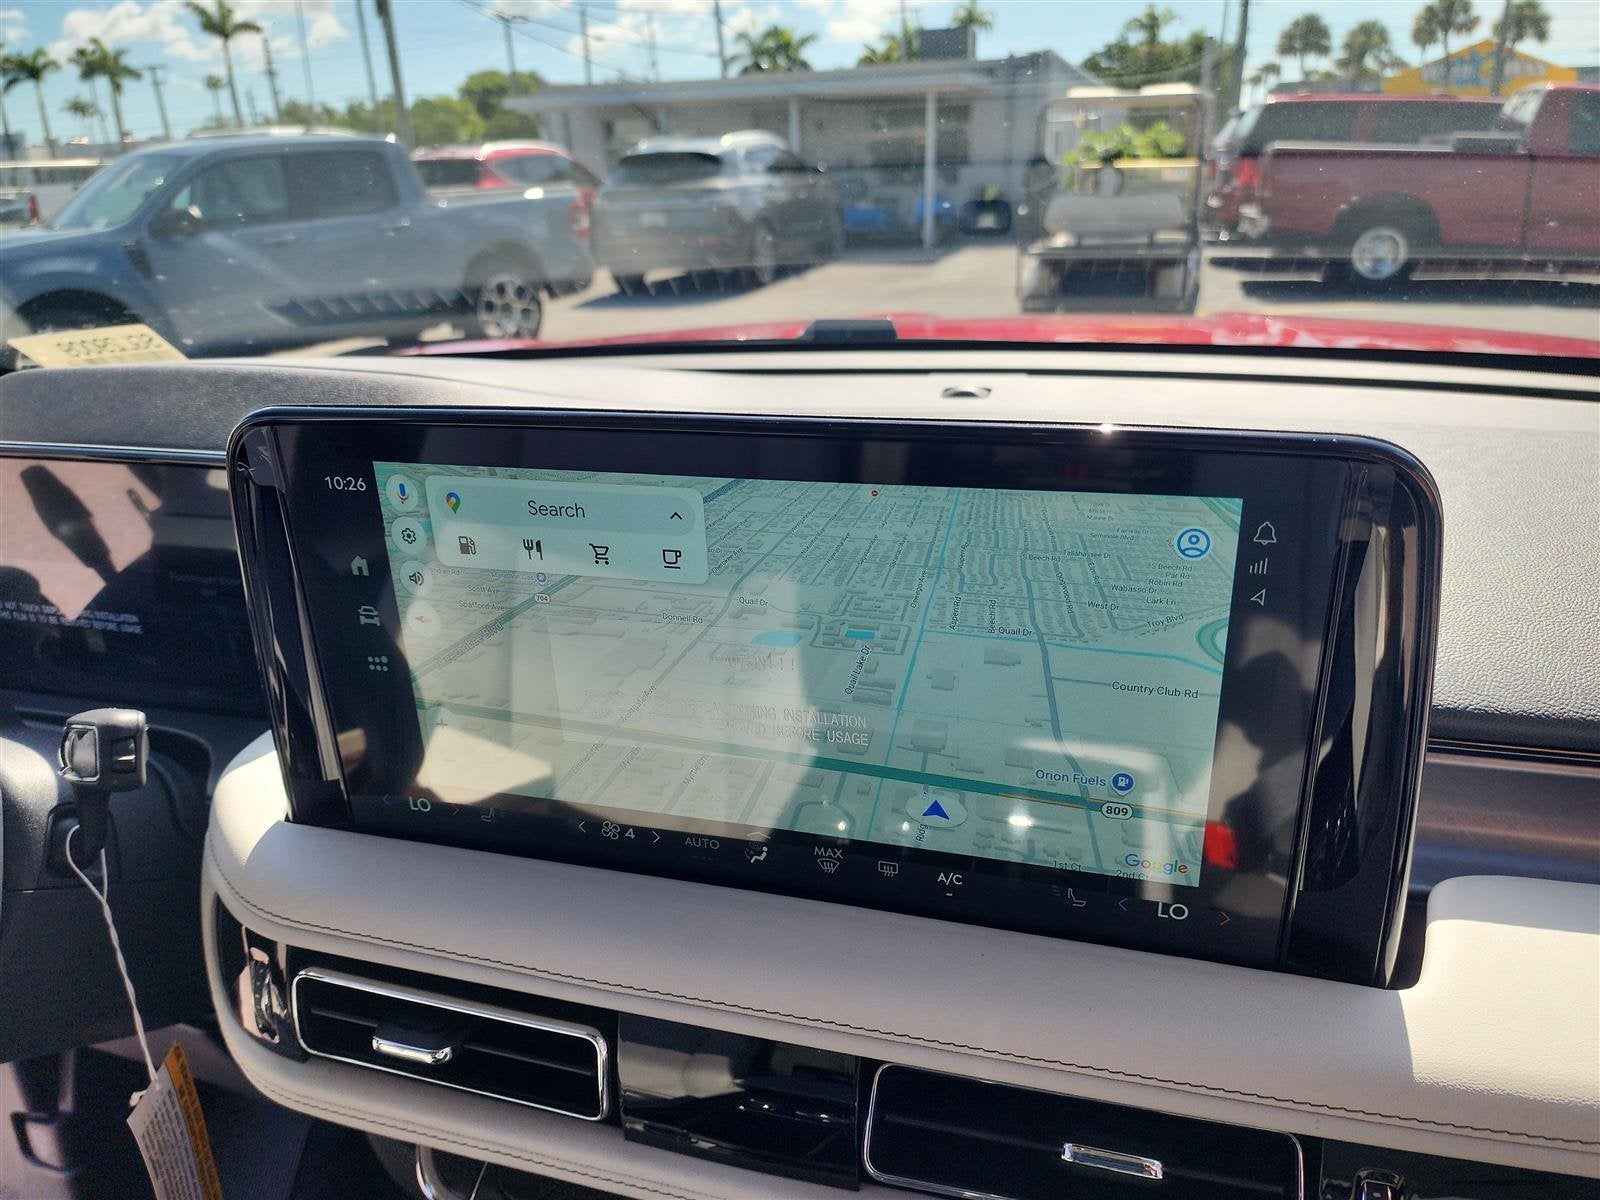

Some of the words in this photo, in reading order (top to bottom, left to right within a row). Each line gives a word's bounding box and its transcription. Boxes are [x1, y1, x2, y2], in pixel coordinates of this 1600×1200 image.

[324, 476, 367, 491] 10:26
[527, 499, 586, 518] Search
[1028, 553, 1050, 561] Beech
[1158, 563, 1182, 571] Beech
[466, 584, 485, 593] Scott
[910, 581, 923, 609] Oswego
[919, 570, 927, 583] Ave
[1055, 571, 1071, 605] Dogwood
[1110, 584, 1147, 594] Wabasso
[1148, 579, 1171, 587] Robin
[458, 599, 489, 611] Spafford
[490, 602, 506, 612] Ave
[738, 596, 759, 605] Quail
[953, 595, 962, 608] Rd
[989, 599, 997, 610] Rd
[1087, 600, 1108, 610] West
[1110, 603, 1120, 611] Dr
[1146, 597, 1164, 606] Lark
[662, 612, 691, 623] Donnell
[692, 615, 703, 624] Rd
[949, 607, 960, 631] Aspen
[988, 610, 996, 634] Beech
[1147, 617, 1166, 629] Troy
[1166, 612, 1185, 625] Blvd
[483, 620, 504, 639] Blvd
[998, 626, 1021, 637] Quail
[1022, 627, 1033, 637] Dr
[844, 673, 857, 695] Quail
[854, 655, 866, 675] Lake
[863, 644, 872, 656] Dr
[1112, 680, 1154, 696] Country
[1156, 685, 1181, 698] Club
[1184, 688, 1199, 700] Rd
[783, 705, 867, 728] INSTALLATION
[827, 730, 870, 746] USAGE
[1035, 769, 1070, 783] Orion
[1072, 773, 1107, 787] Fuels
[409, 796, 431, 812] LO
[1105, 805, 1129, 816] 809
[625, 828, 636, 839] 4
[915, 823, 929, 842] Ridg
[685, 836, 720, 850] AUTO
[813, 846, 844, 859] MAX
[1052, 860, 1068, 870] 1st
[1124, 853, 1188, 875] Google
[937, 872, 963, 886] A/C
[1115, 869, 1135, 879] 2nd
[1157, 901, 1189, 920] LO
